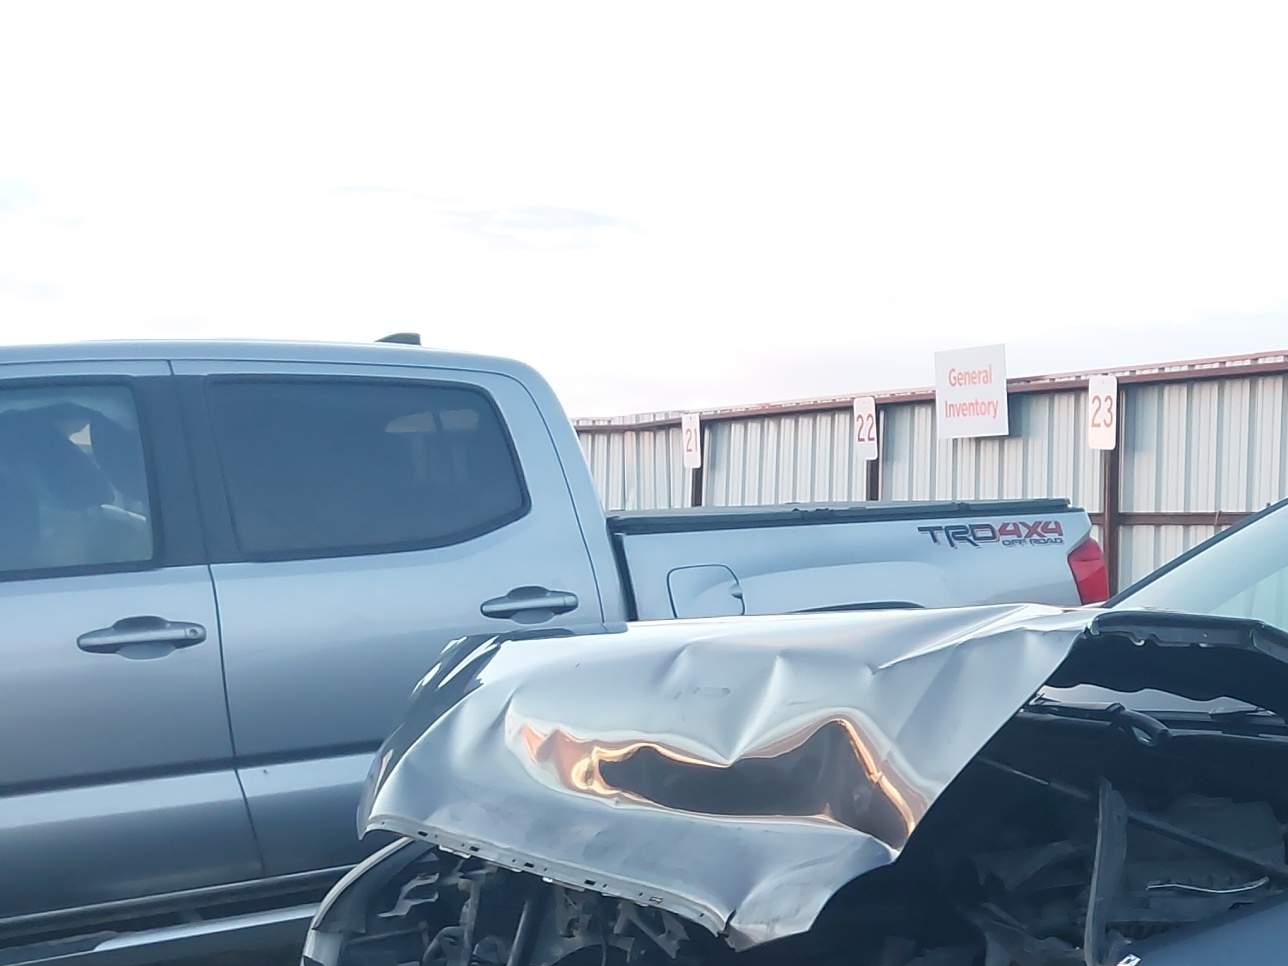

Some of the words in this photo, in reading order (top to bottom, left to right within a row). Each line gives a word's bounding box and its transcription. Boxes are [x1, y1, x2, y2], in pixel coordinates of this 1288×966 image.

[949, 363, 993, 387] General
[945, 399, 999, 420] Inventory
[1091, 394, 1114, 428] 23
[856, 413, 876, 443] 22
[685, 428, 698, 453] 21
[1030, 537, 1064, 545] ROAD
